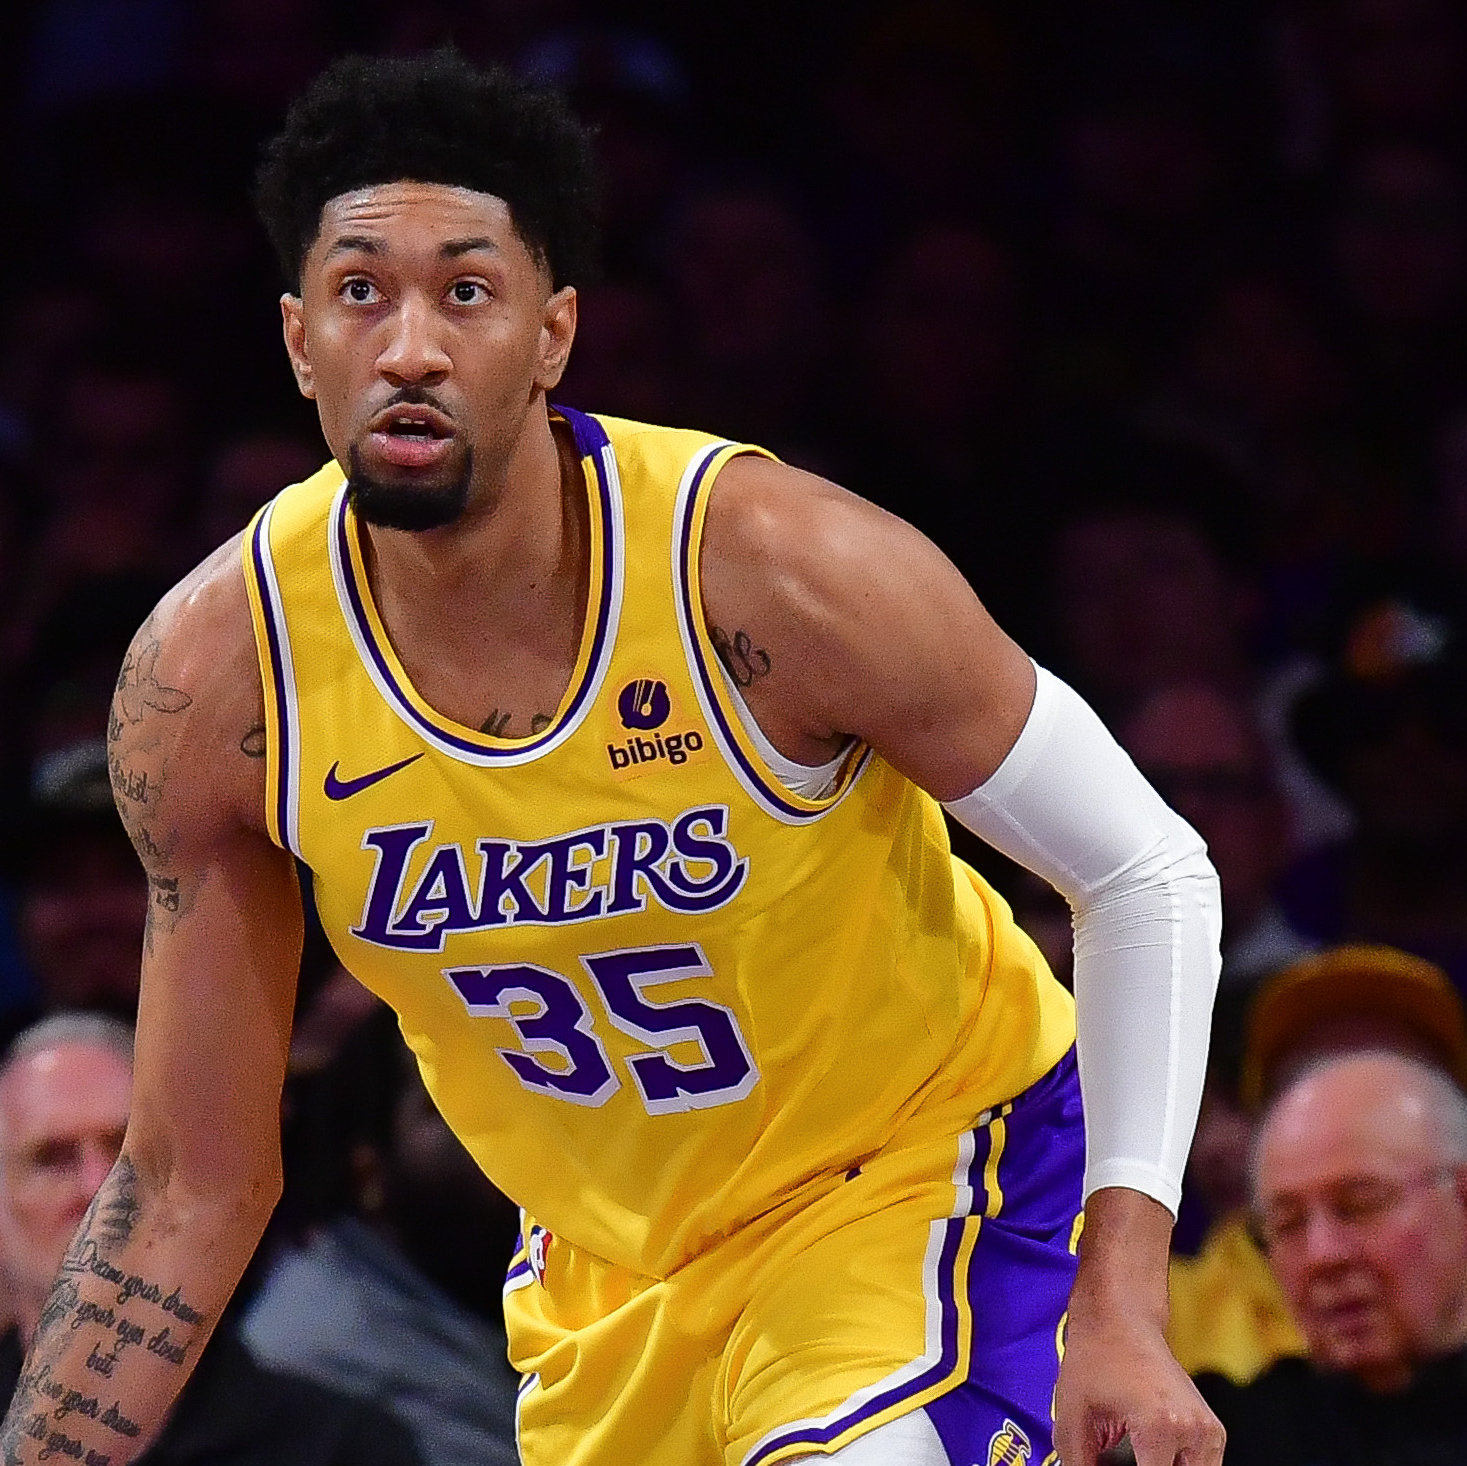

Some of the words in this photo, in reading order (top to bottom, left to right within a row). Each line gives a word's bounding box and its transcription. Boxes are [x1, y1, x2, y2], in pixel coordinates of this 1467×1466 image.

[607, 729, 703, 771] bibigo
[349, 804, 750, 953] LAKERS
[441, 942, 762, 1116] 35
